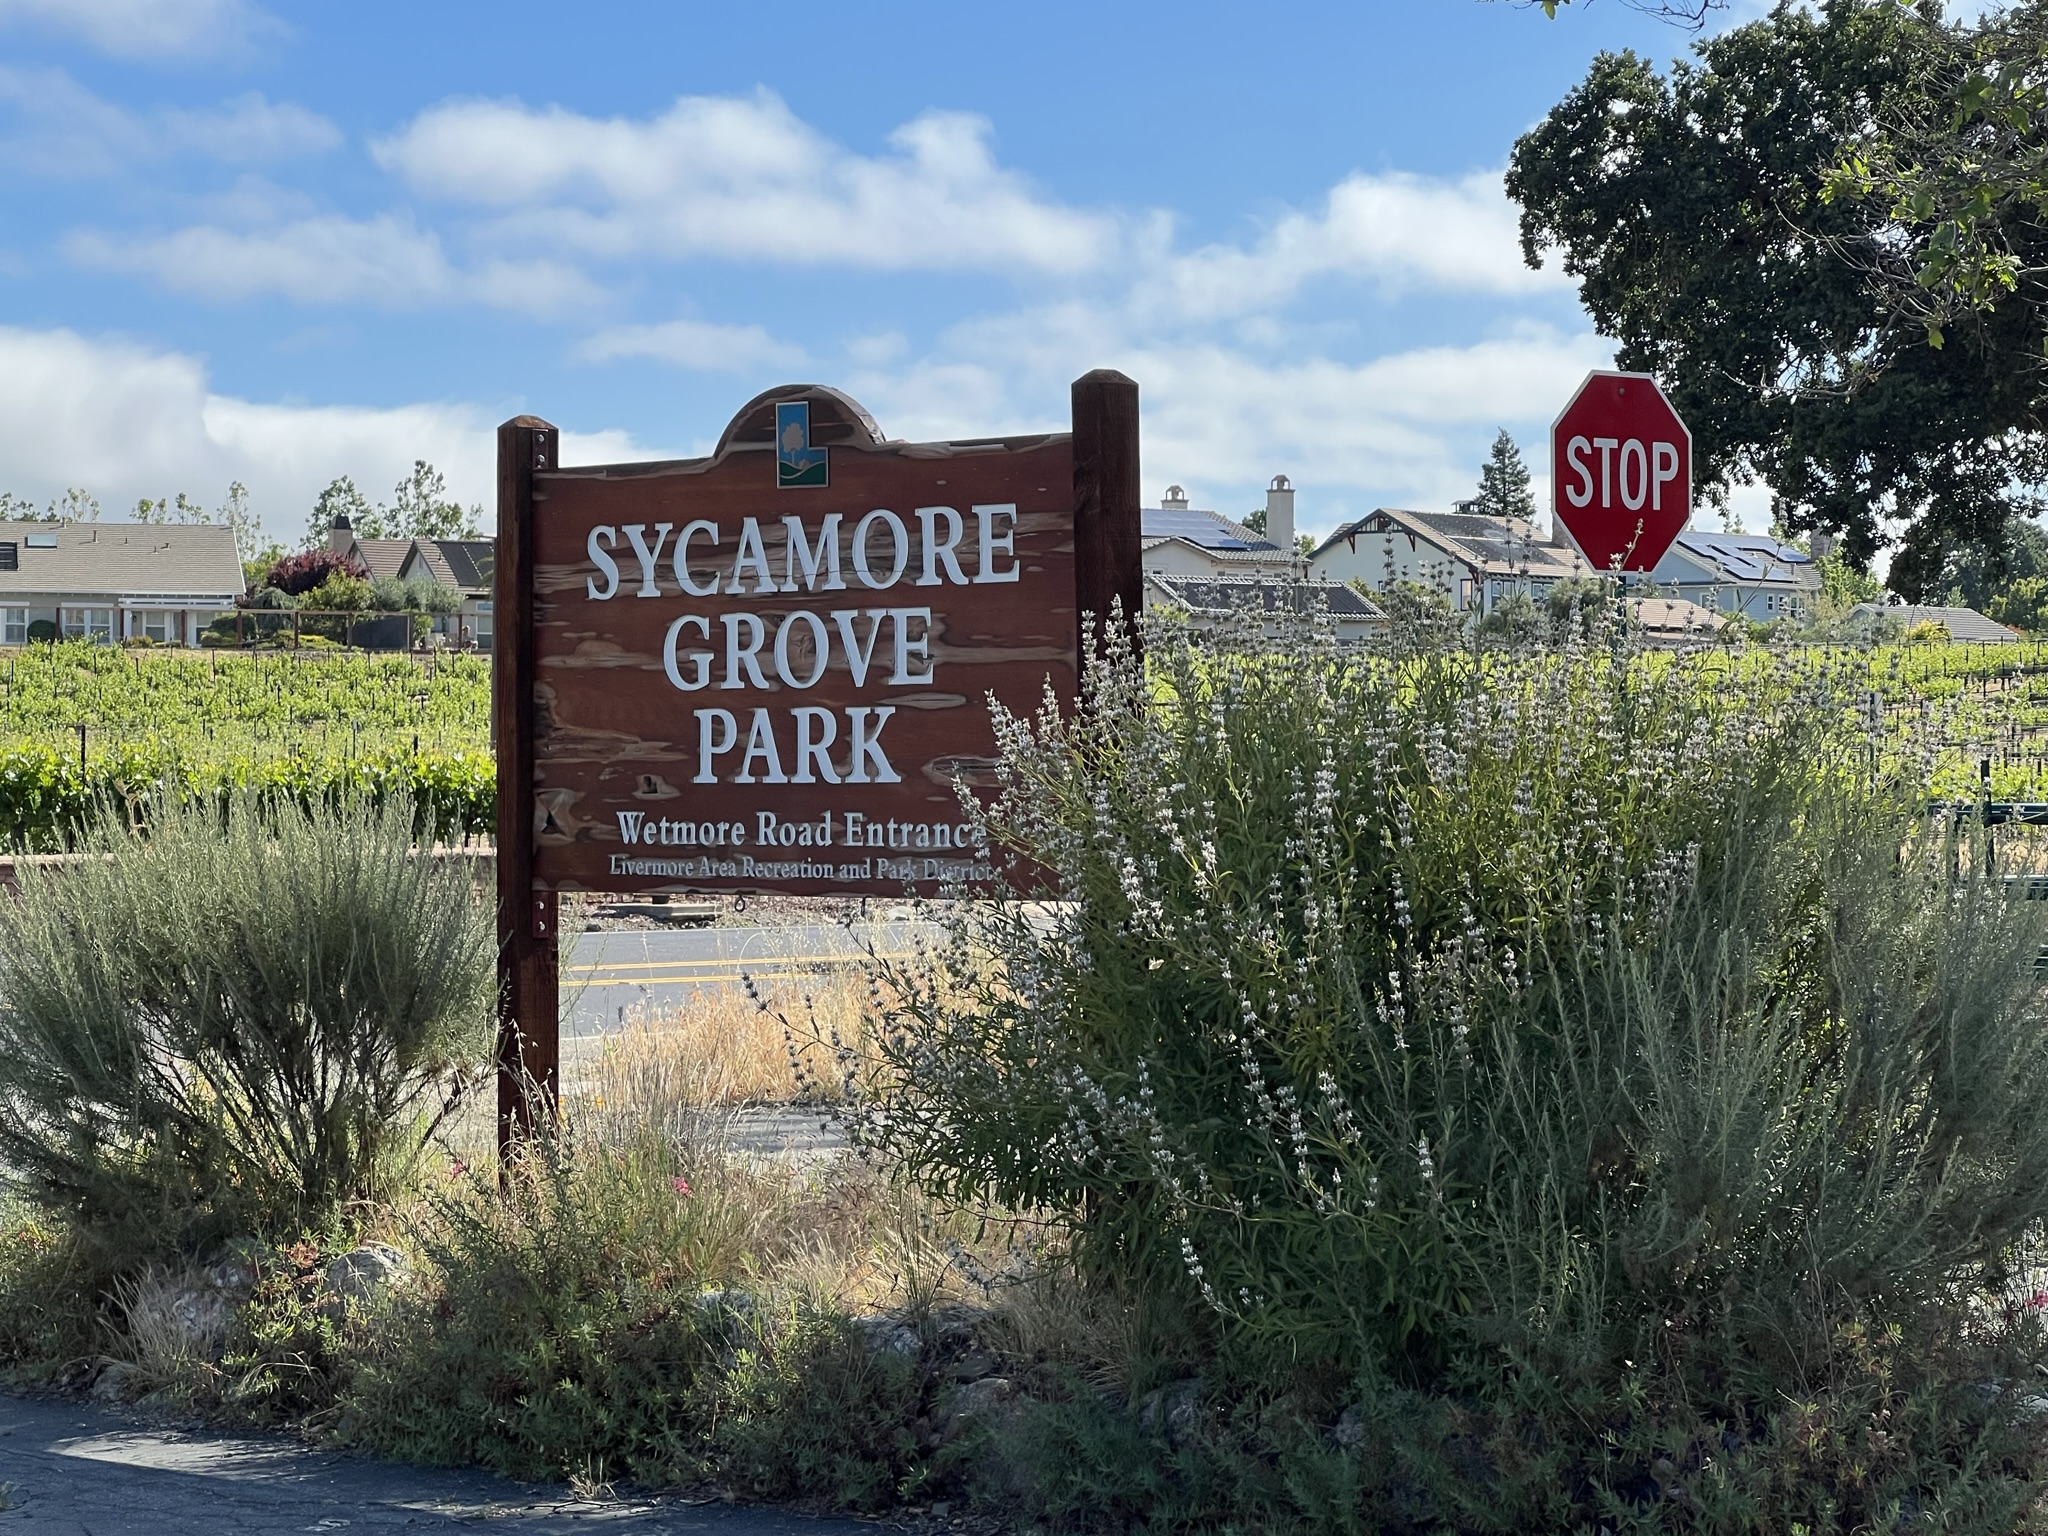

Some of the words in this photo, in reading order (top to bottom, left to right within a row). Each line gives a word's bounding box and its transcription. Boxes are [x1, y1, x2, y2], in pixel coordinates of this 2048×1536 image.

[1565, 435, 1679, 511] STOP
[586, 502, 1021, 600] SYCAMORE
[663, 606, 935, 691] GROVE
[692, 705, 902, 786] PARK
[608, 854, 694, 877] Livermore
[699, 855, 737, 878] Area
[742, 855, 834, 879] Recreation
[839, 856, 872, 880] and
[876, 857, 918, 881] Park
[616, 811, 746, 846] Wetmore
[756, 809, 833, 847] Road
[843, 811, 988, 848] Entrance
